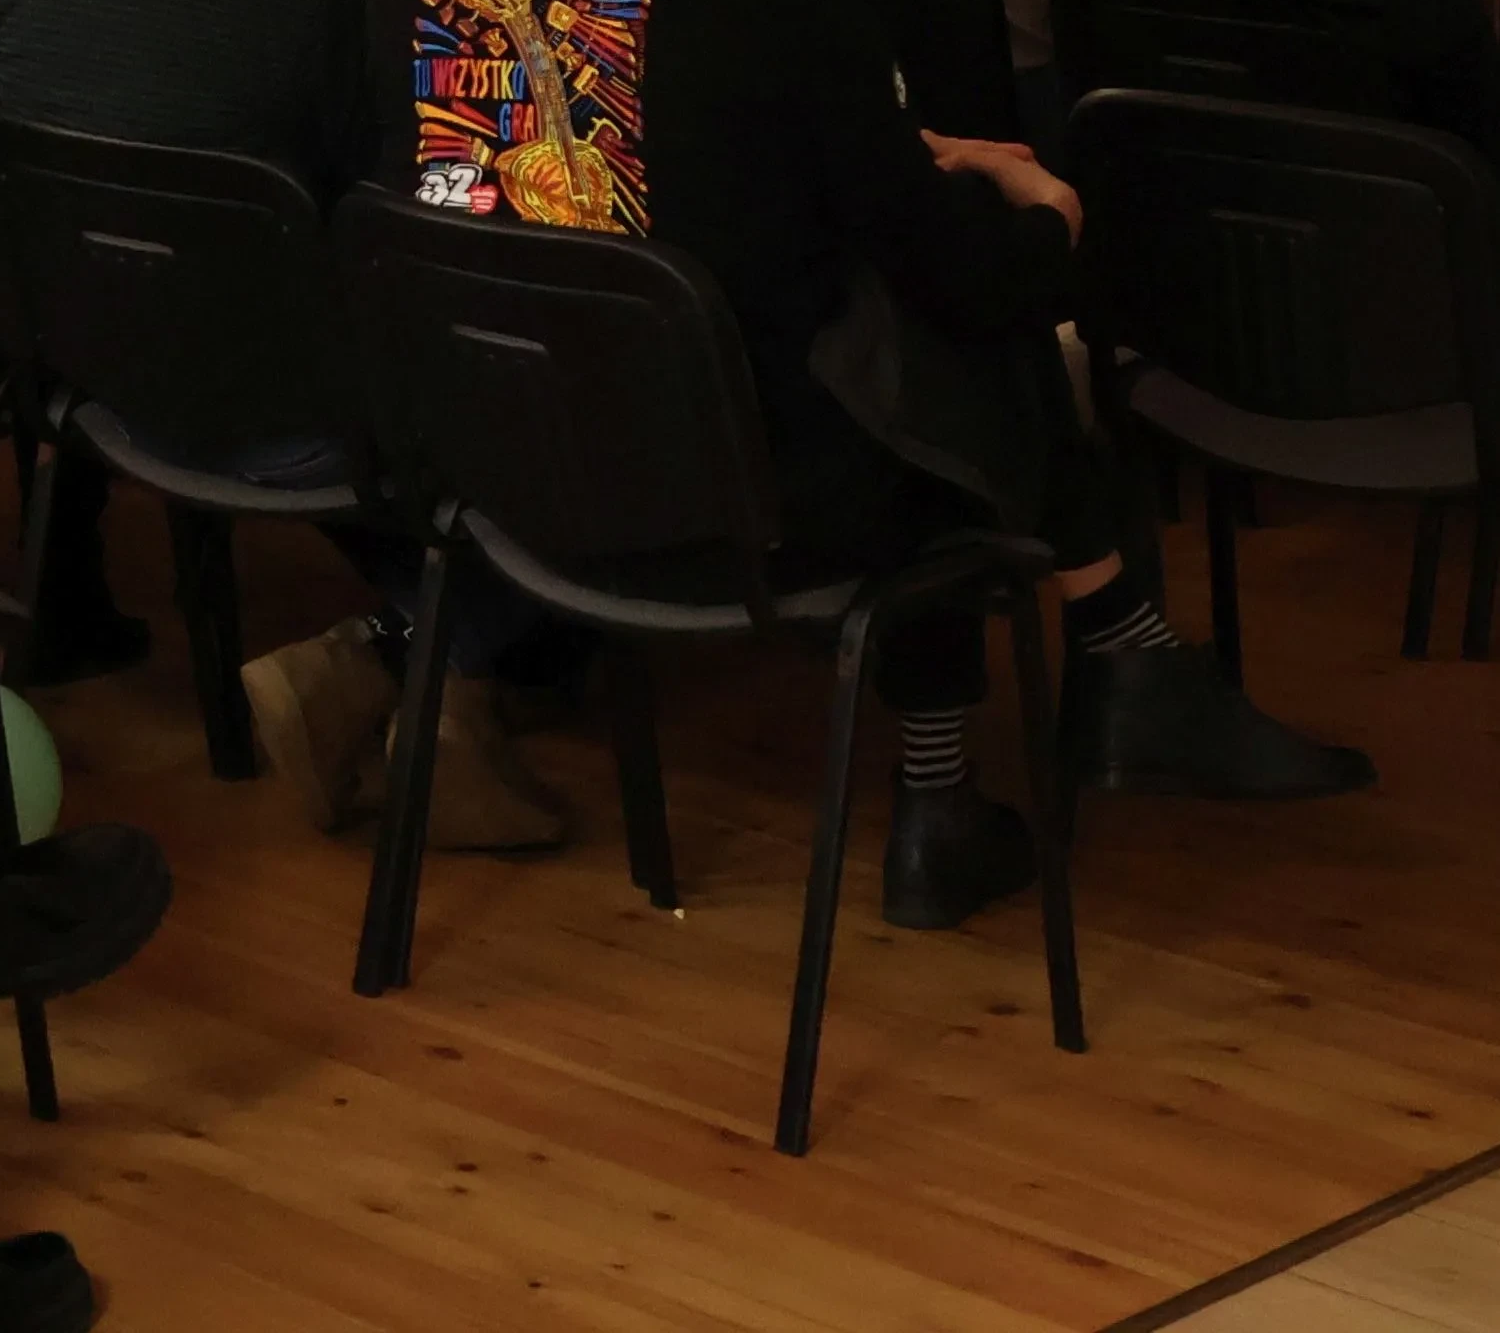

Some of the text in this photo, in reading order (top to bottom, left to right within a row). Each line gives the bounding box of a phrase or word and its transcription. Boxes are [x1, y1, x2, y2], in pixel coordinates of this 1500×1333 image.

[412, 58, 526, 100] TU WSZYSTKO
[499, 102, 536, 143] GRA
[416, 164, 480, 207] 32
